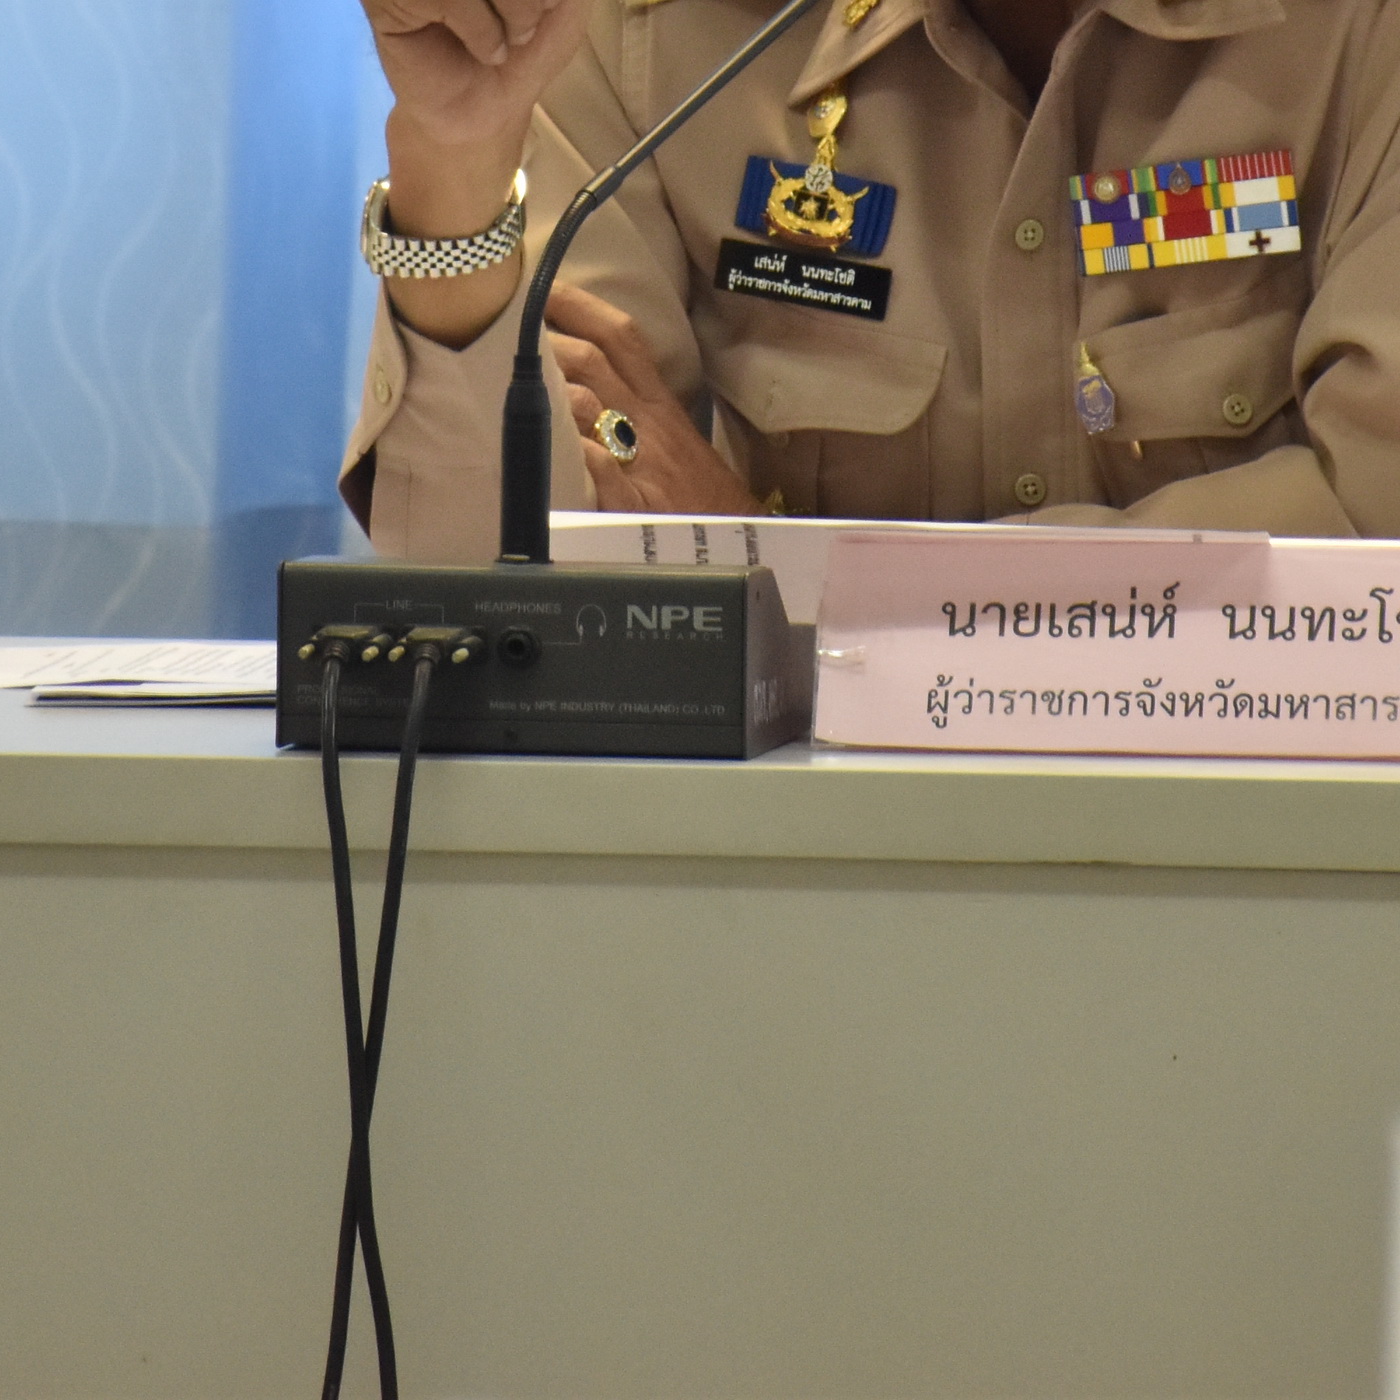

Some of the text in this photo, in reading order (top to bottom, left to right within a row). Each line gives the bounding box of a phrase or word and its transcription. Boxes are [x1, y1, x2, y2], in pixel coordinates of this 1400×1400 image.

[385, 599, 413, 612] LINE
[474, 601, 562, 615] HEADPHONES
[941, 581, 1181, 638] นายเสน่ห์
[625, 604, 724, 631] NPE
[535, 701, 557, 711] NPE
[560, 701, 615, 712] INDUSTRY
[618, 703, 679, 714] (THAILAND)
